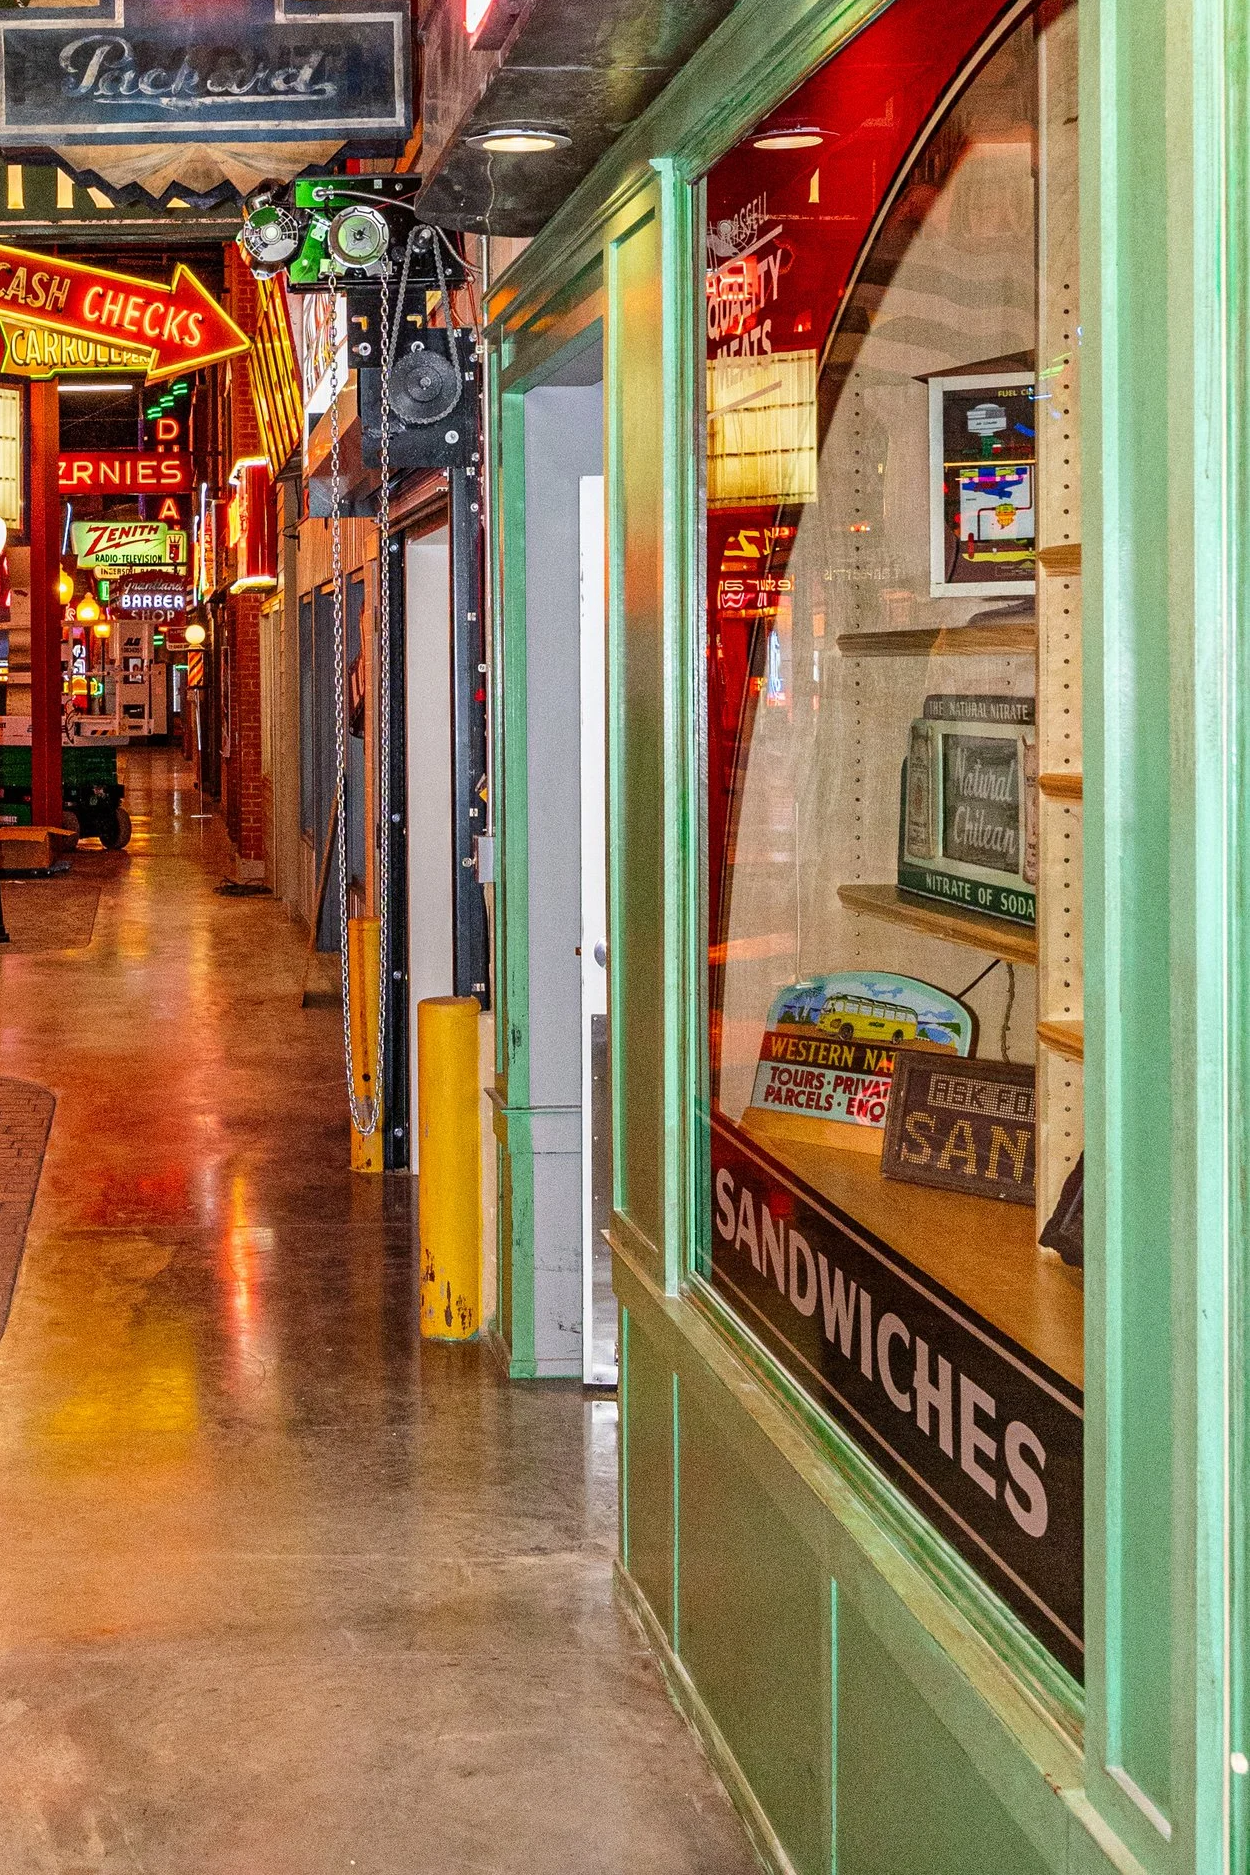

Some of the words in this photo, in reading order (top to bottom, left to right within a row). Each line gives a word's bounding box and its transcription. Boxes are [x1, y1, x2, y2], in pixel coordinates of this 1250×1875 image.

[58, 34, 337, 107] Packard
[84, 287, 203, 346] CHECKS
[84, 525, 160, 557] ZENITH
[95, 554, 118, 564] RADIO
[121, 554, 163, 565] TELEVISION
[122, 594, 185, 609] BARBER
[131, 610, 176, 623] SHOP
[949, 701, 988, 718] NATURAL
[990, 703, 1031, 721] NITRATE
[954, 747, 1016, 803] Natural
[953, 806, 1017, 855] Chilean
[926, 873, 971, 901] NITRATE
[978, 887, 993, 906] OF
[1000, 893, 1035, 919] SODA
[771, 1036, 855, 1069] WESTERN
[770, 1066, 824, 1091] TOURS
[934, 1079, 988, 1110] ASK
[764, 1085, 834, 1112] PARCELS
[846, 1097, 886, 1123] ENQ
[902, 1112, 1036, 1185] SAN
[715, 1166, 1050, 1538] SANDWICHES
